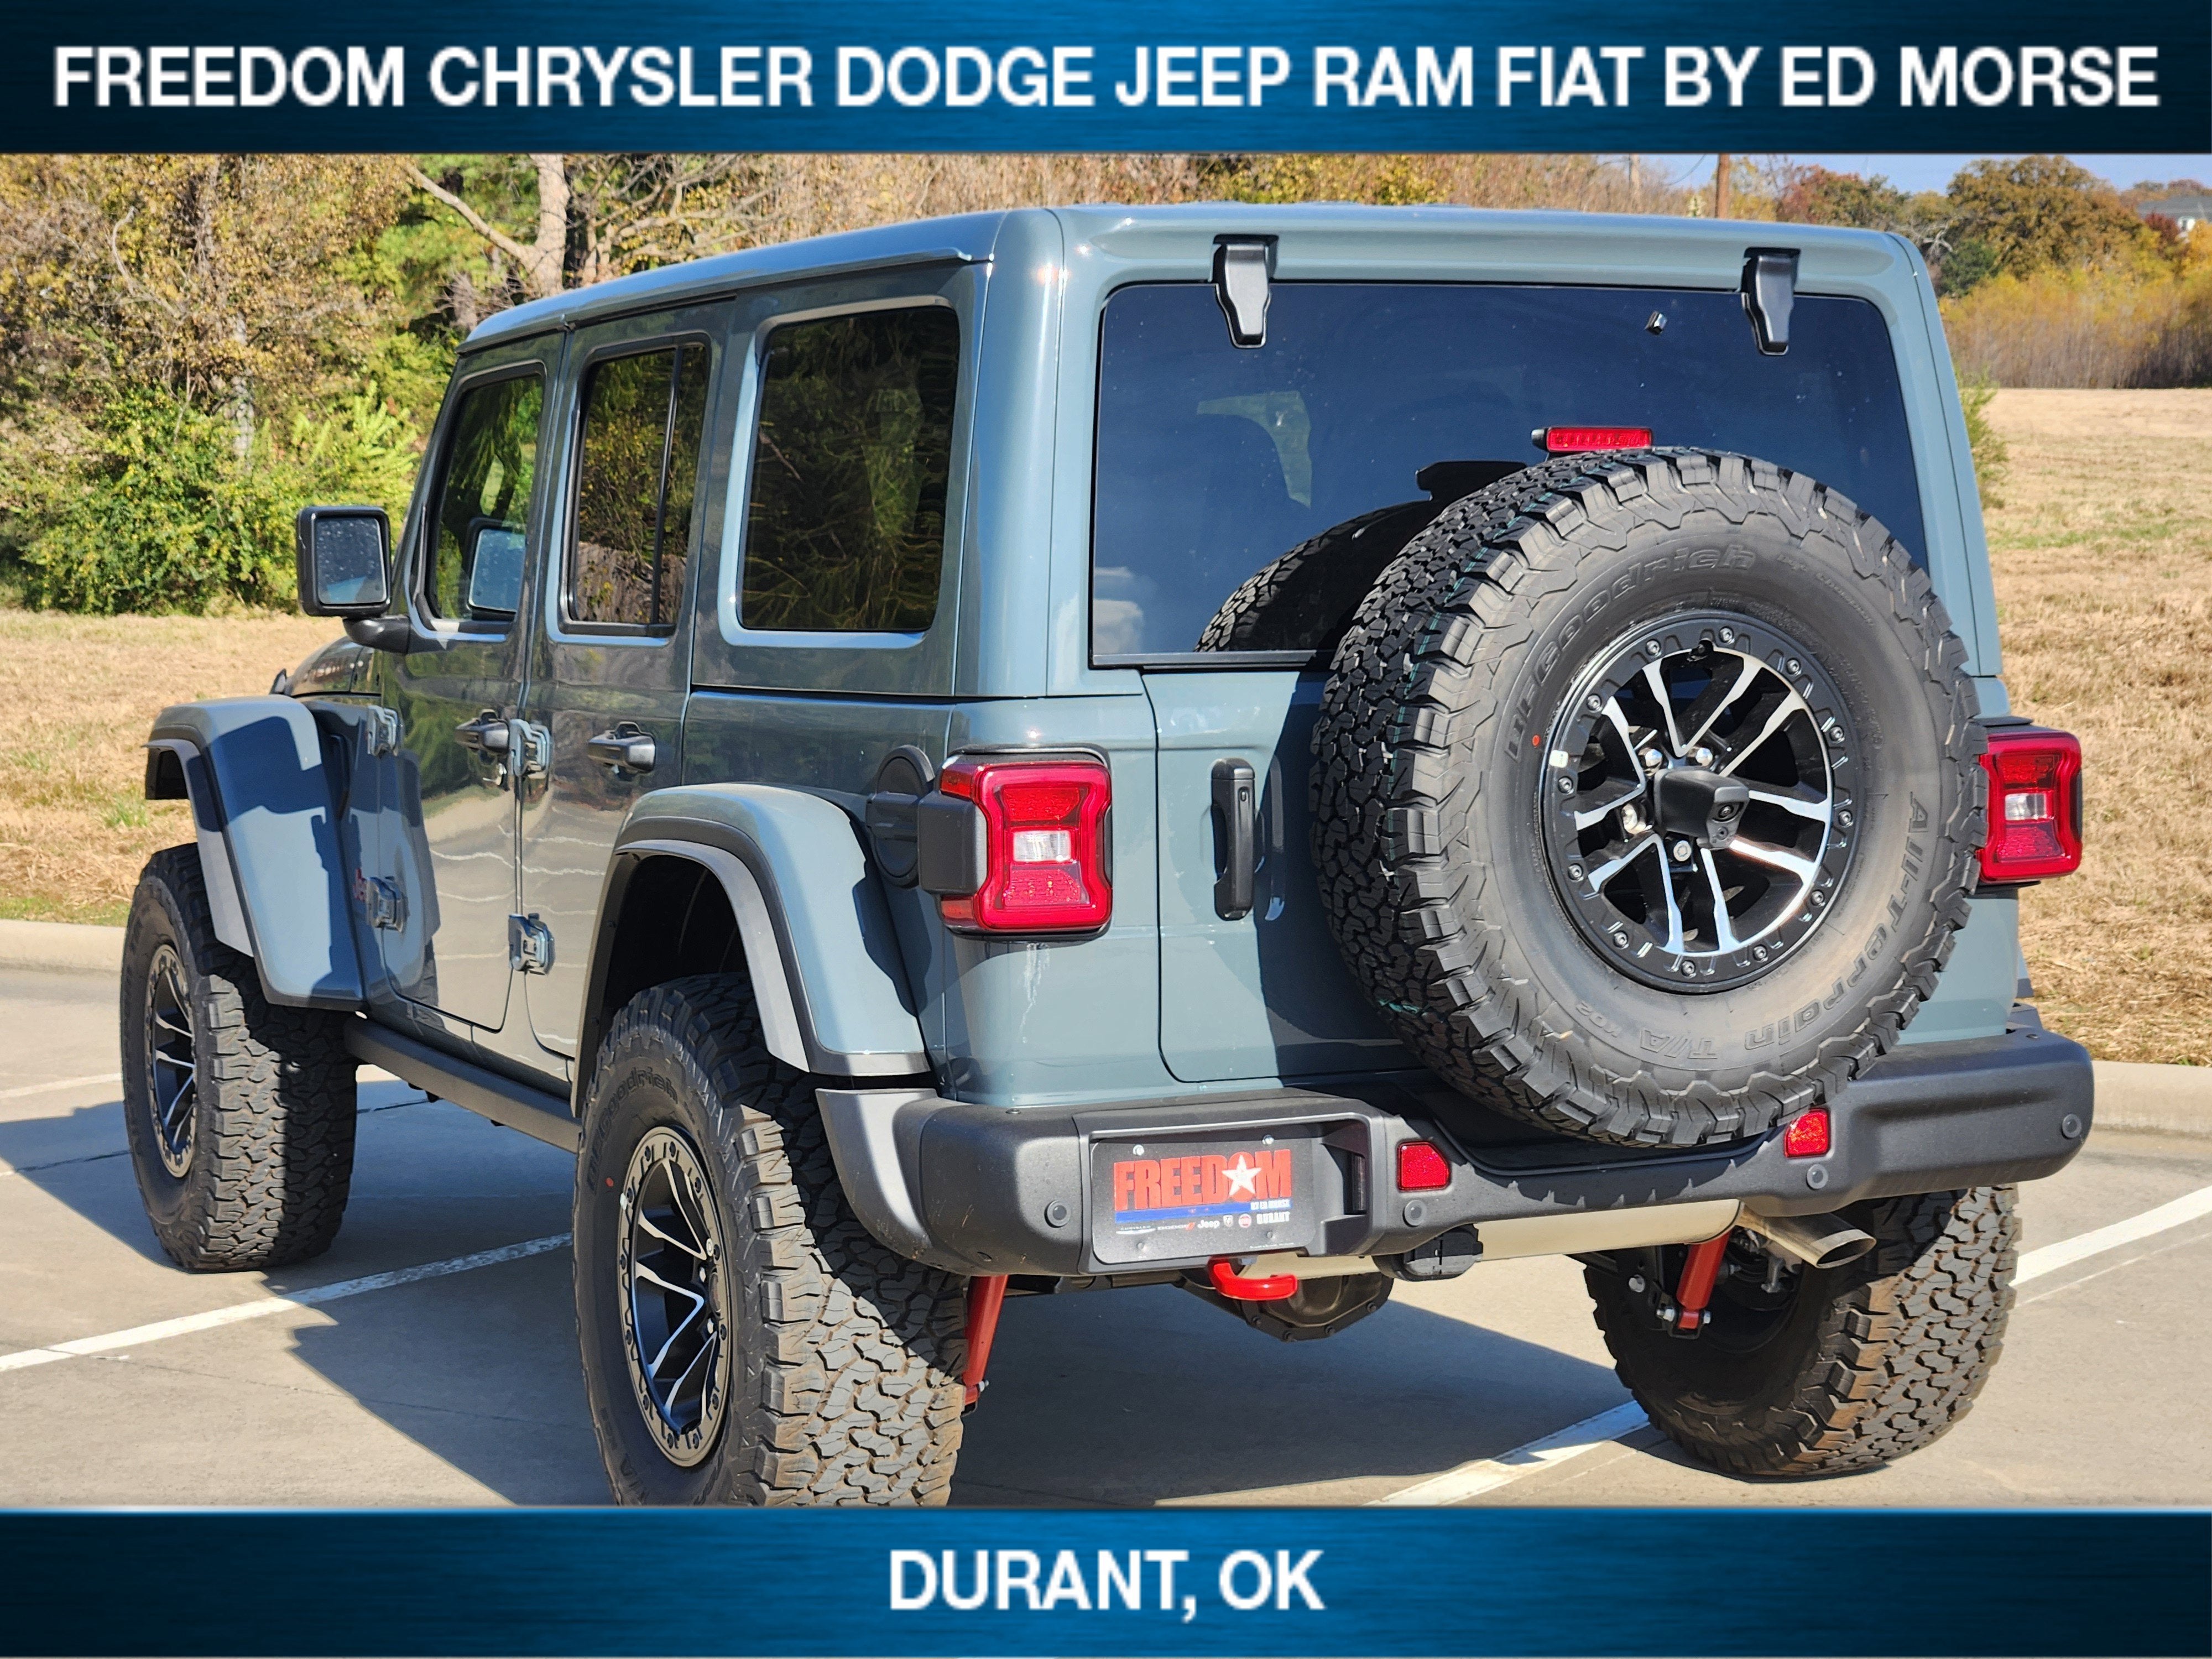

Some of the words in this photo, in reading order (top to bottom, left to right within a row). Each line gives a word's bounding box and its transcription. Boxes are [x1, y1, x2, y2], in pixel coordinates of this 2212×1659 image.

[1504, 544, 1756, 763] BFGoodrich
[1744, 791, 1929, 1050] All-Terrain
[1114, 1149, 1292, 1211] FREEDOM
[1197, 1219, 1220, 1229] Jeep
[1256, 1211, 1290, 1225] DURANT
